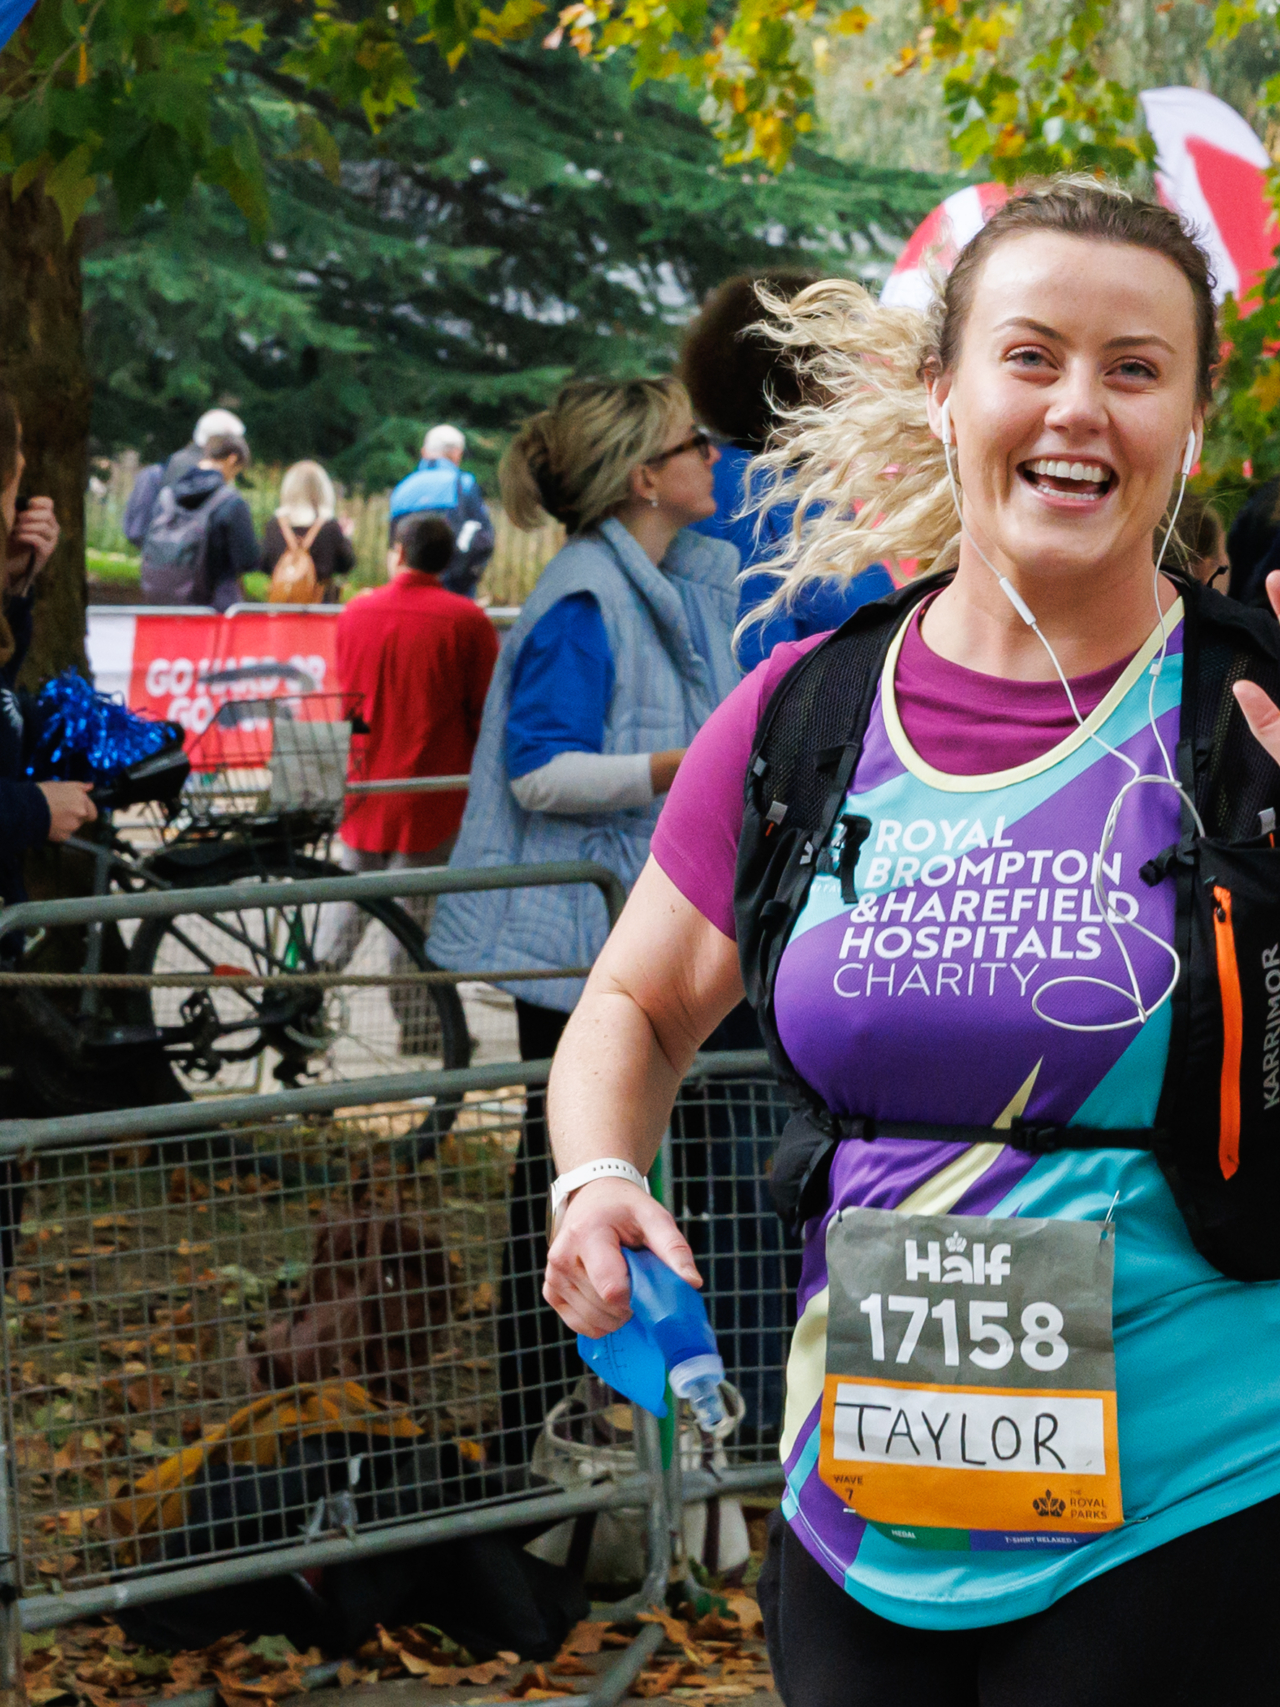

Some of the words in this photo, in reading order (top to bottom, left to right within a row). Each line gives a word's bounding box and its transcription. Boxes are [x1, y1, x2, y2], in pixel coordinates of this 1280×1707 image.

[145, 657, 194, 697] GO
[167, 697, 214, 735] GO
[875, 816, 1013, 852] ROYAL
[863, 849, 1122, 889] BROMPTON
[850, 887, 1140, 924] &HAREFIELD
[838, 925, 1102, 960] HOSPITALS
[833, 962, 1040, 997] CHARITY
[904, 1238, 1012, 1285] Half
[860, 1293, 1069, 1372] 17158
[833, 1402, 1066, 1470] TAYLOR
[833, 1475, 863, 1486] WAVE
[845, 1489, 854, 1501] 7
[1069, 1497, 1107, 1509] ROYAL
[1070, 1509, 1108, 1520] PARKS
